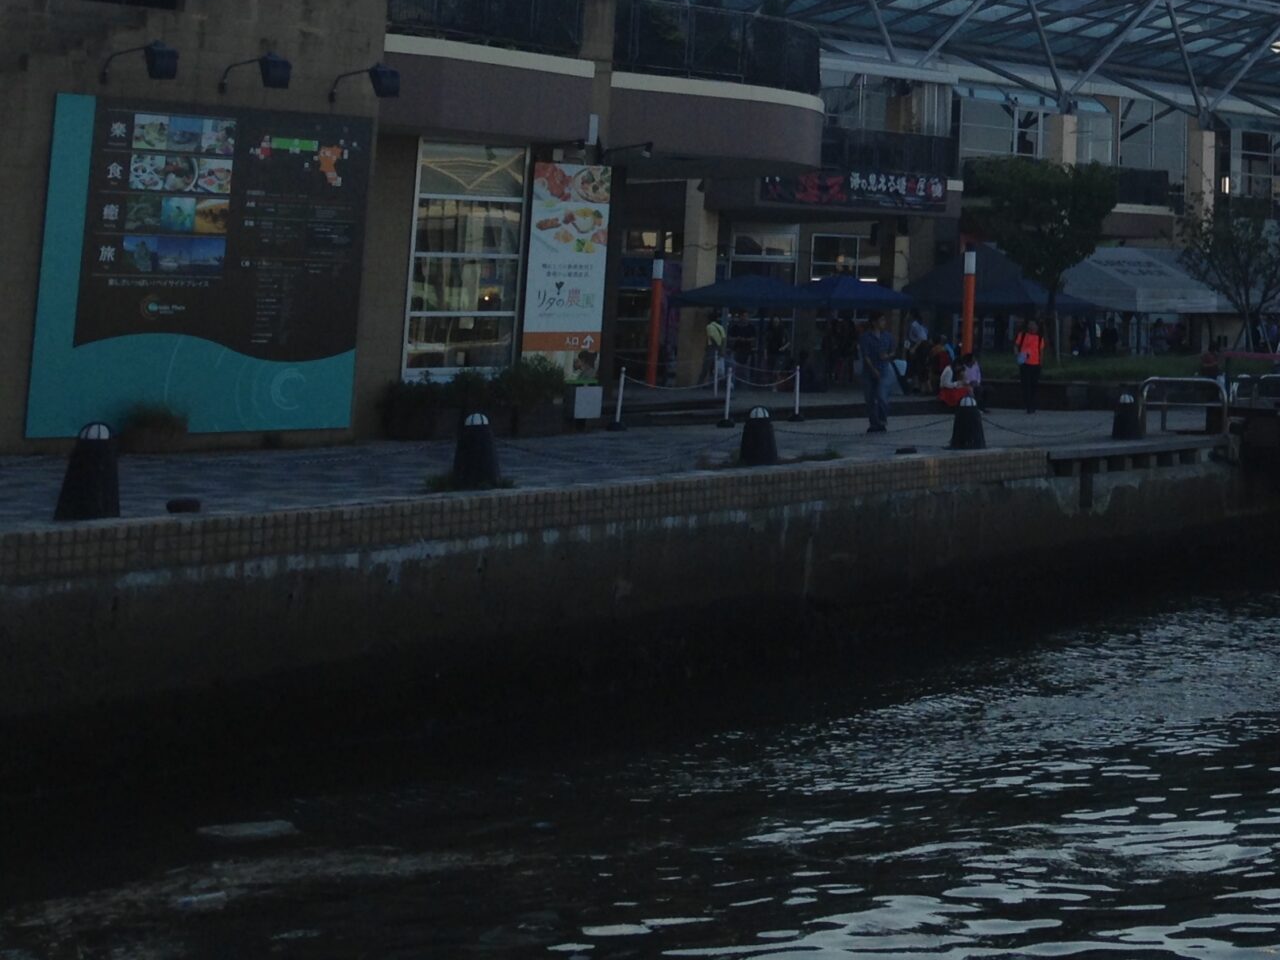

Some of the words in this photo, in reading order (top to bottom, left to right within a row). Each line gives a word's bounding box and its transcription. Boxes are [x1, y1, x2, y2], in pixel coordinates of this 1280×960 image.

[110, 122, 127, 138] 楽
[107, 161, 123, 180] 食
[98, 245, 116, 263] 旅
